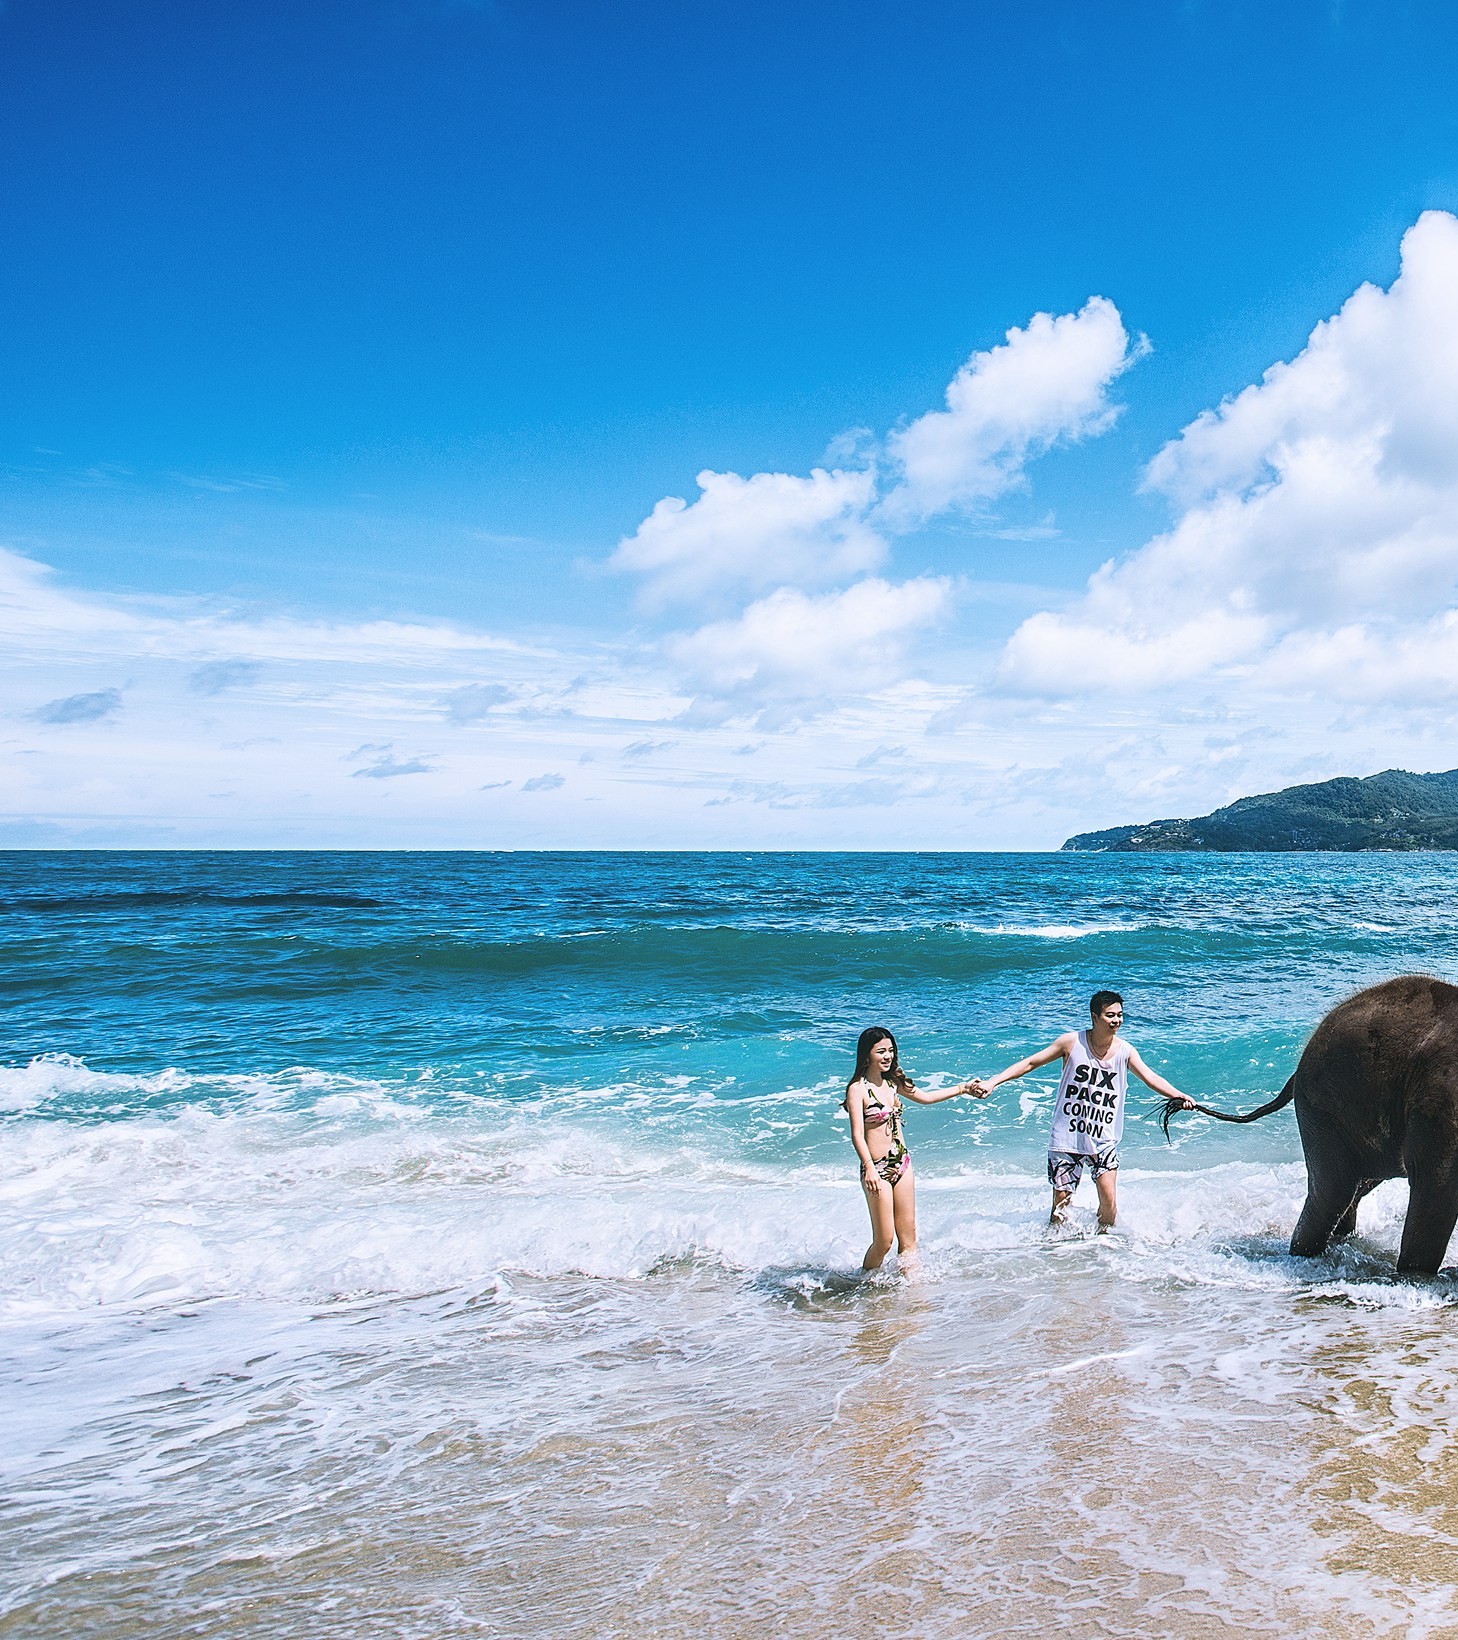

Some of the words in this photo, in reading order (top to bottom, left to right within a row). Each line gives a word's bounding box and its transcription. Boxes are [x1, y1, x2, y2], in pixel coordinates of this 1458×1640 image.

[1074, 1064, 1117, 1090] SIX
[1065, 1084, 1118, 1109] PACK
[1063, 1102, 1114, 1124] COMING
[1068, 1119, 1104, 1139] SOON
